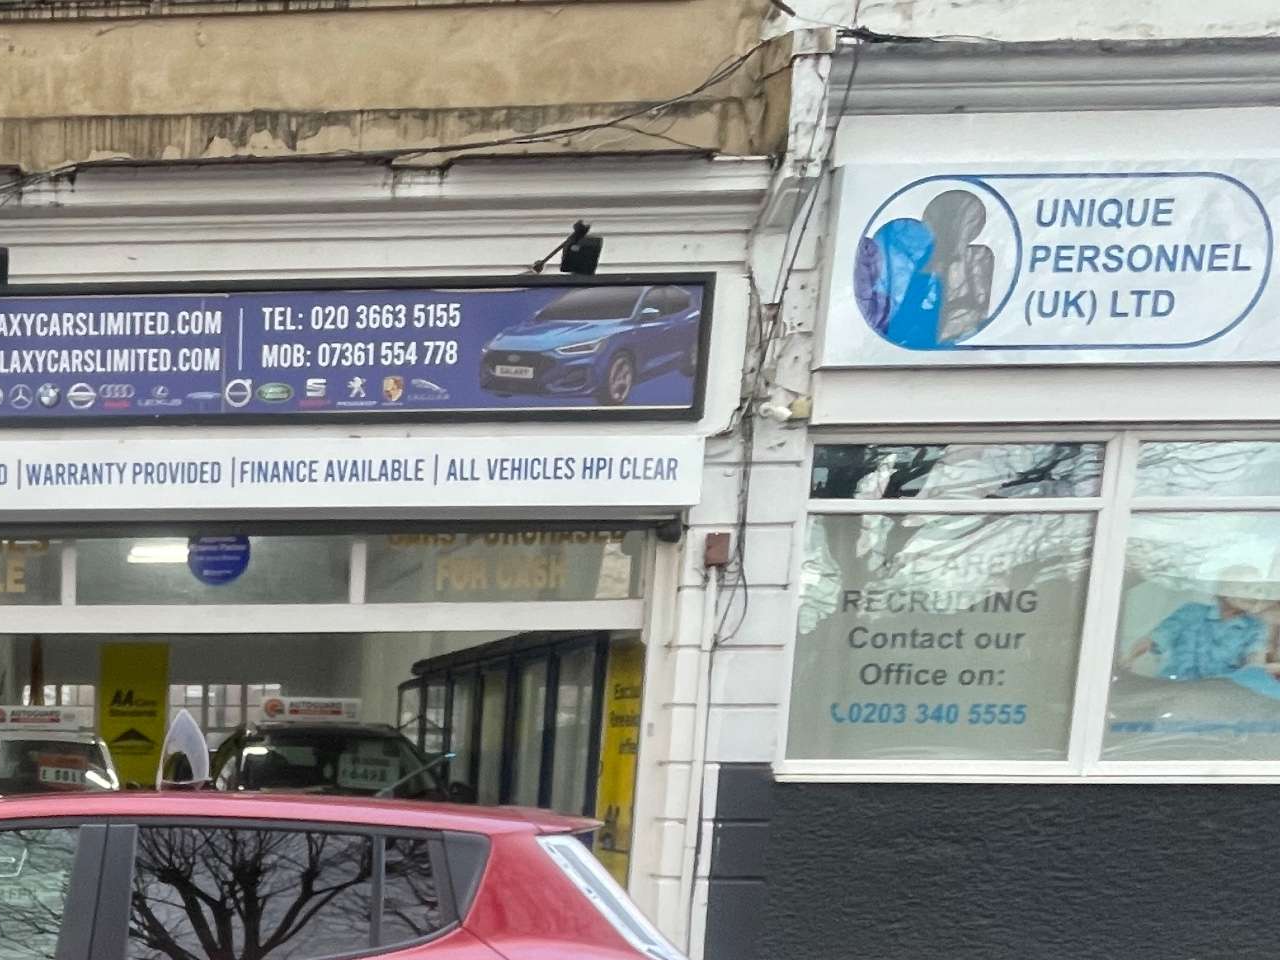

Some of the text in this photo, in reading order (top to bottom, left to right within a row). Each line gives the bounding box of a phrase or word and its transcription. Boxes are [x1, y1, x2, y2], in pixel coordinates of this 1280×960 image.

[1035, 198, 1175, 229] UNIQUE
[1029, 243, 1252, 273] PERSONNEL
[262, 306, 303, 331] TEL:
[310, 305, 349, 330] 020
[355, 304, 406, 329] 3663
[413, 303, 461, 329] 5155
[1025, 289, 1176, 325] (UK) LTD
[262, 343, 311, 368] MOB:
[318, 342, 375, 367] 07361
[380, 341, 417, 366] 554
[423, 340, 458, 365] 778
[26, 461, 126, 486] WARRANTY
[132, 460, 221, 485] PROVIDED
[240, 459, 318, 483] FINANCE
[324, 458, 425, 482] AVAILABLE
[446, 458, 480, 482] ALL
[487, 457, 575, 481] VEHICLES
[581, 456, 612, 480] HPI
[619, 456, 678, 481] CLEAR
[848, 626, 1026, 650] Contact our
[858, 662, 1006, 687] Office on:
[848, 703, 1028, 726] 0203 340 5555
